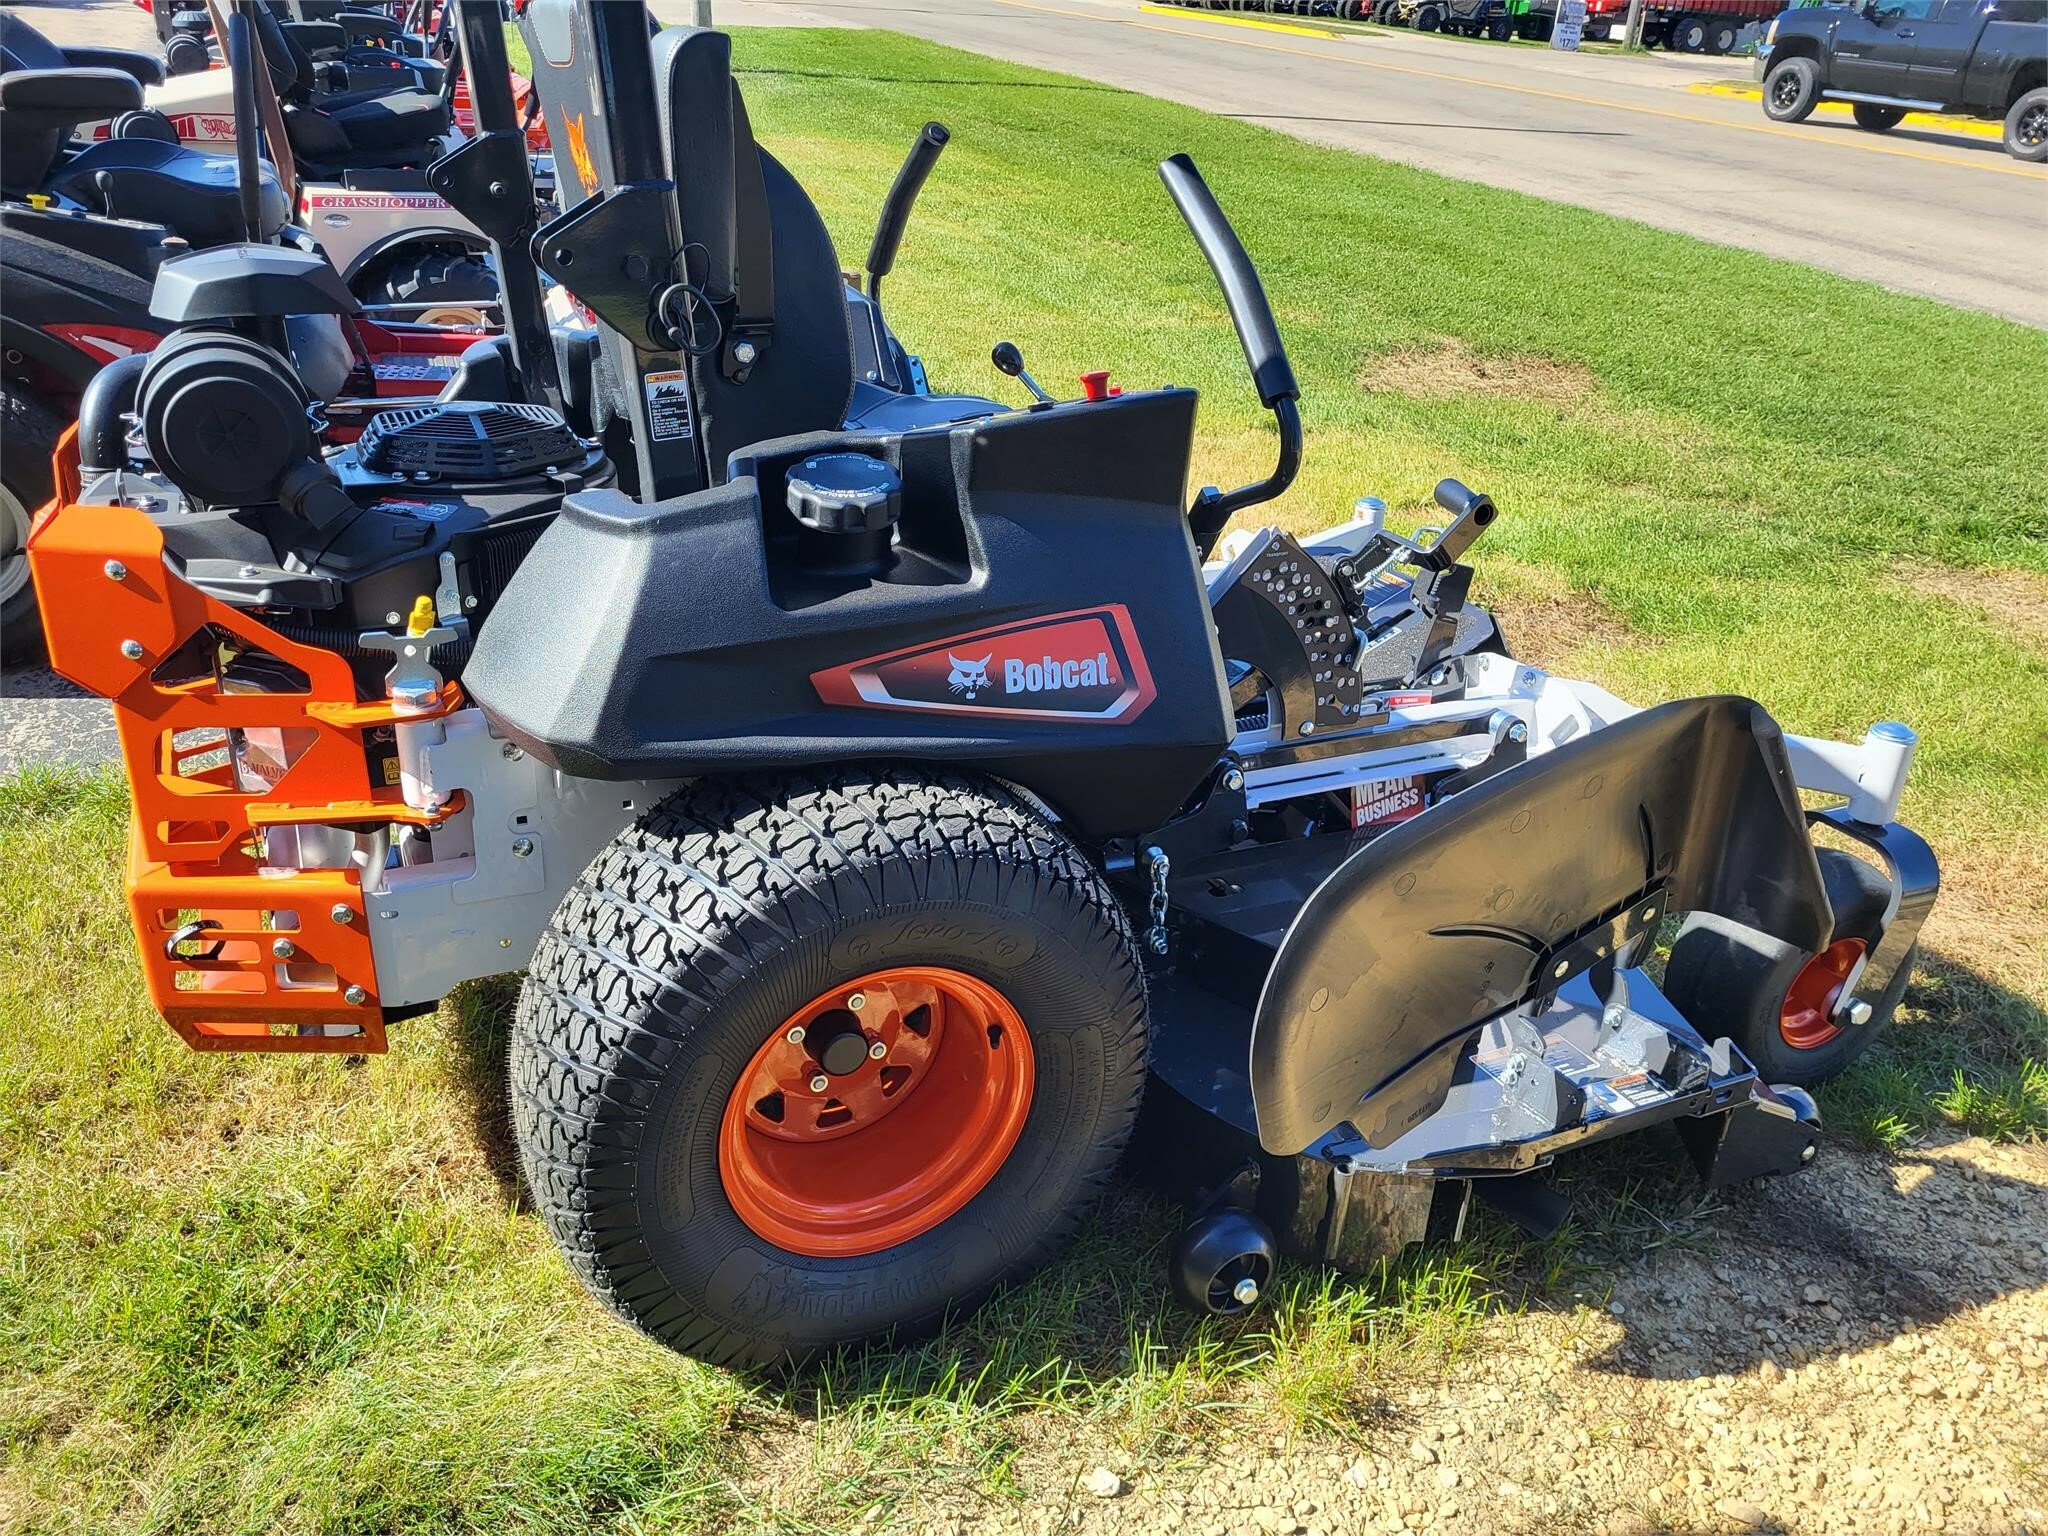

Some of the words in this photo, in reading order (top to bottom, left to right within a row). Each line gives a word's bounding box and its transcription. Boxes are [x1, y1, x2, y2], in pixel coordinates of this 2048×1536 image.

[321, 197, 446, 208] GRASSHOPPER
[655, 373, 683, 381] WARNING
[1005, 652, 1109, 693] Bobcat
[1356, 776, 1413, 808] MEAN
[1356, 788, 1419, 827] BUSINESS
[788, 1256, 954, 1320] ARMSTRONG
